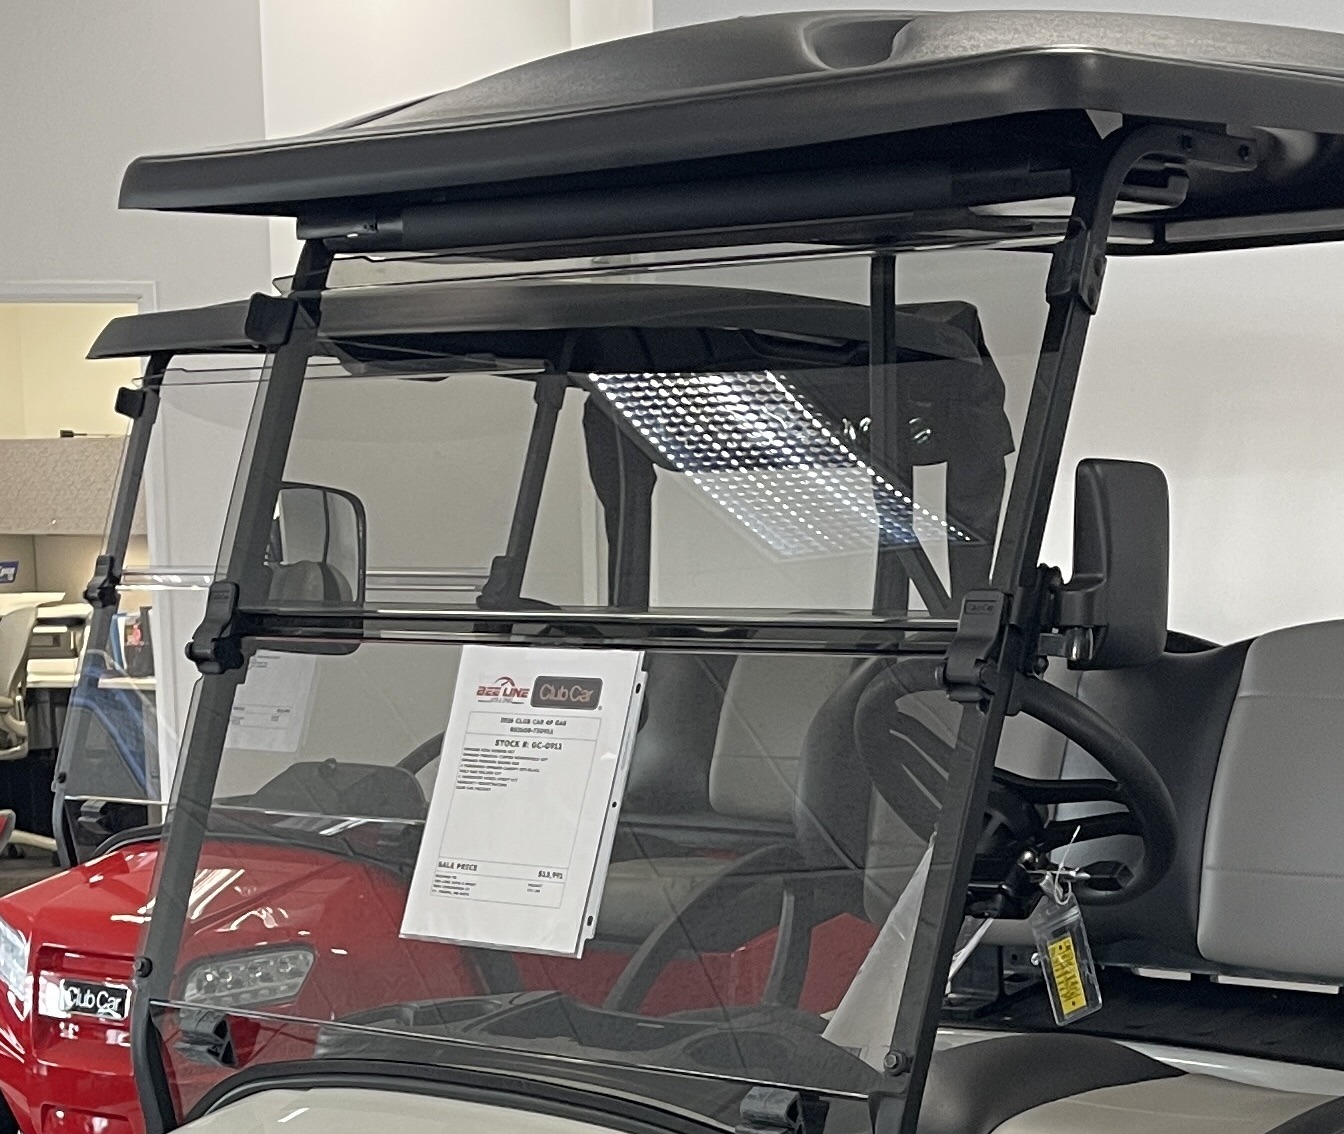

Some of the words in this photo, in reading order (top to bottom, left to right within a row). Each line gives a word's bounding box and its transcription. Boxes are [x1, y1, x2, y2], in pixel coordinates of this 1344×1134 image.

[477, 685, 502, 697] BEE
[502, 687, 531, 699] LINE
[539, 683, 569, 701] Club
[569, 685, 594, 703] Car
[495, 739, 520, 748] STOCK
[437, 861, 455, 870] SALE
[456, 863, 478, 872] PRICE
[65, 986, 96, 1009] Club
[96, 990, 123, 1011] Car
